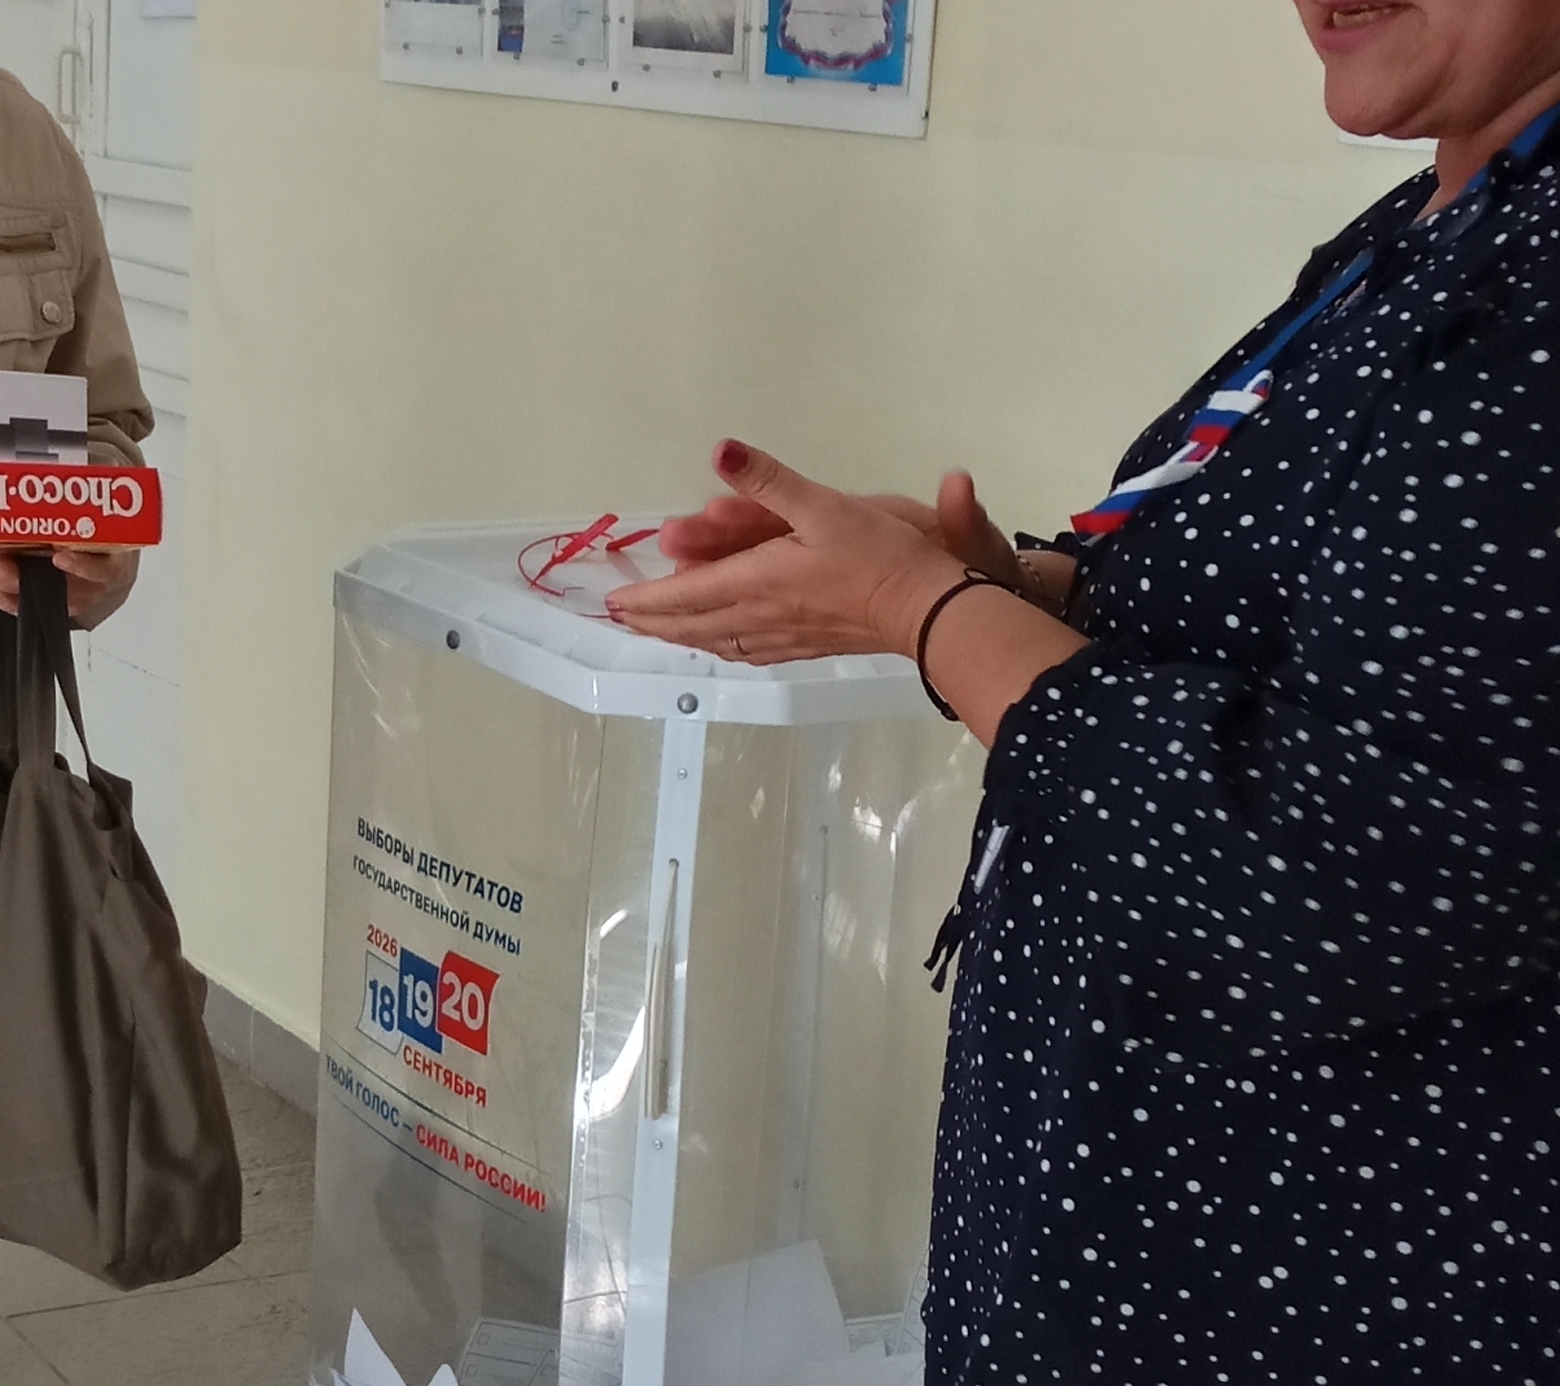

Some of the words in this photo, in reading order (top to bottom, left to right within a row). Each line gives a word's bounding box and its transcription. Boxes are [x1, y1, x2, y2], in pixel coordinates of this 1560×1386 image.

[0, 517, 71, 535] ORION
[357, 816, 414, 867] ВЫБОРЫ
[417, 851, 524, 914] ДЕПУТАТОВ
[353, 854, 471, 931] ГОСУДАРСТВЕННОЙ
[473, 918, 521, 957] ДУМЫ
[366, 924, 398, 958] 2026
[368, 978, 396, 1034] 18
[402, 973, 434, 1029] 19
[441, 970, 486, 1032] 20
[402, 1045, 487, 1108] СЕНТЯБРЯ
[325, 1054, 353, 1096] ТВОЙ
[354, 1080, 400, 1128] ГОЛОС
[415, 1122, 460, 1168] СИЛА
[463, 1154, 547, 1213] РОССИИ!
